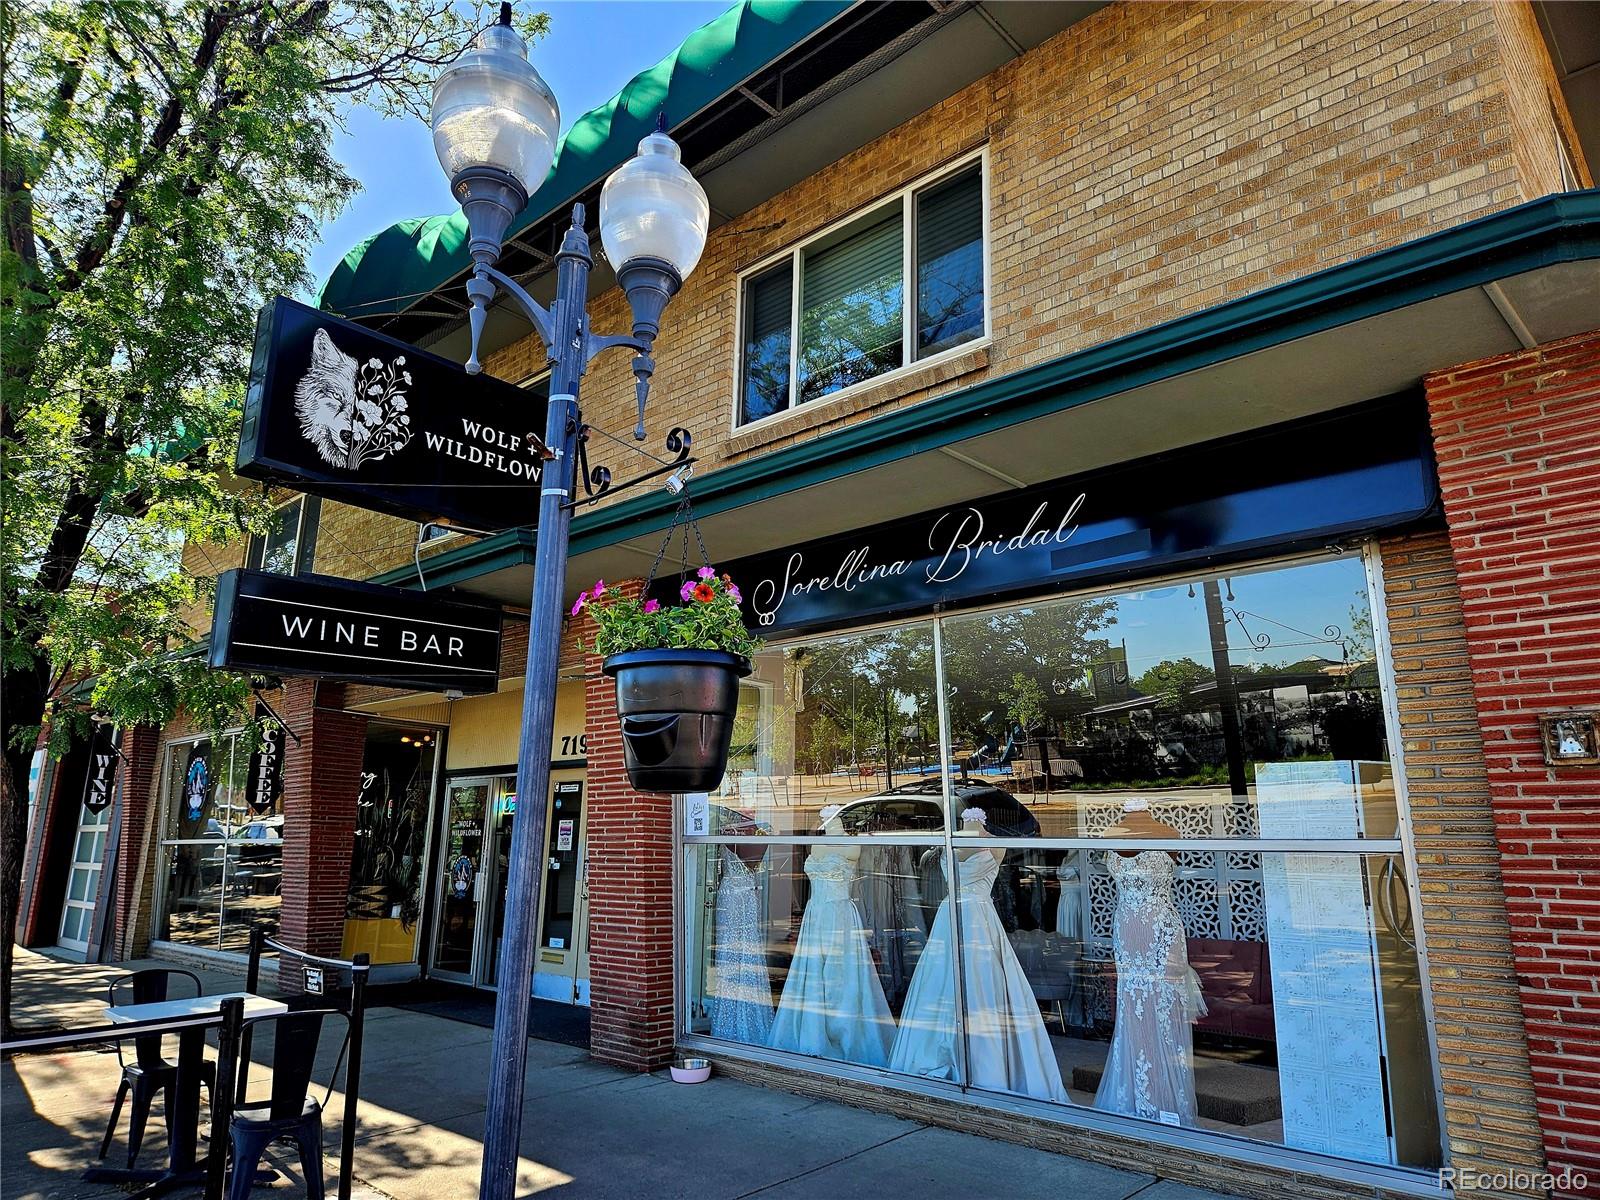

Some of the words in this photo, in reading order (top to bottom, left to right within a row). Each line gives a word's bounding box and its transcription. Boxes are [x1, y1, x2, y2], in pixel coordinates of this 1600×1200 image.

[425, 431, 542, 482] WILDFLOW
[462, 418, 521, 452] WOLF
[752, 544, 913, 624] Sorellina
[925, 493, 1086, 584] Bridal
[281, 614, 380, 648] WINE
[400, 630, 465, 657] BAR
[255, 729, 279, 803] COFFEE
[561, 734, 588, 756] 719
[88, 754, 113, 805] WINE
